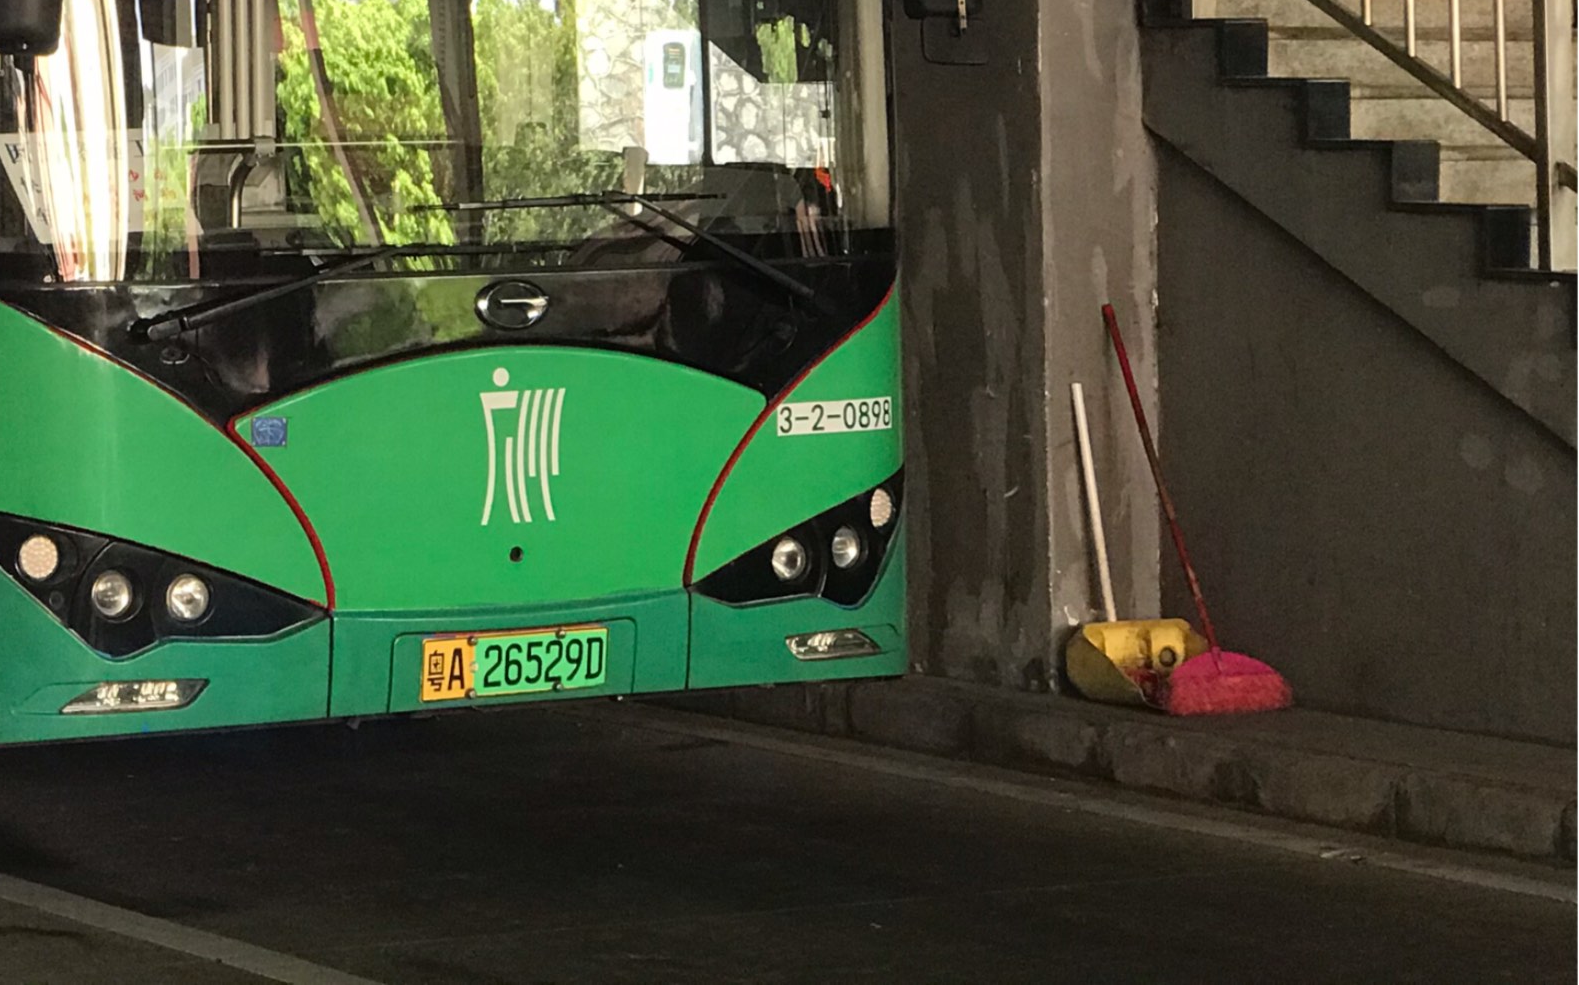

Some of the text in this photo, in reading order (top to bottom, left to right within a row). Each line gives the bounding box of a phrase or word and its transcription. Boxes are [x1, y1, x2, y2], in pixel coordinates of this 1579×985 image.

[779, 399, 891, 434] 3-2-0898
[427, 636, 604, 692] 粤A 26529D
